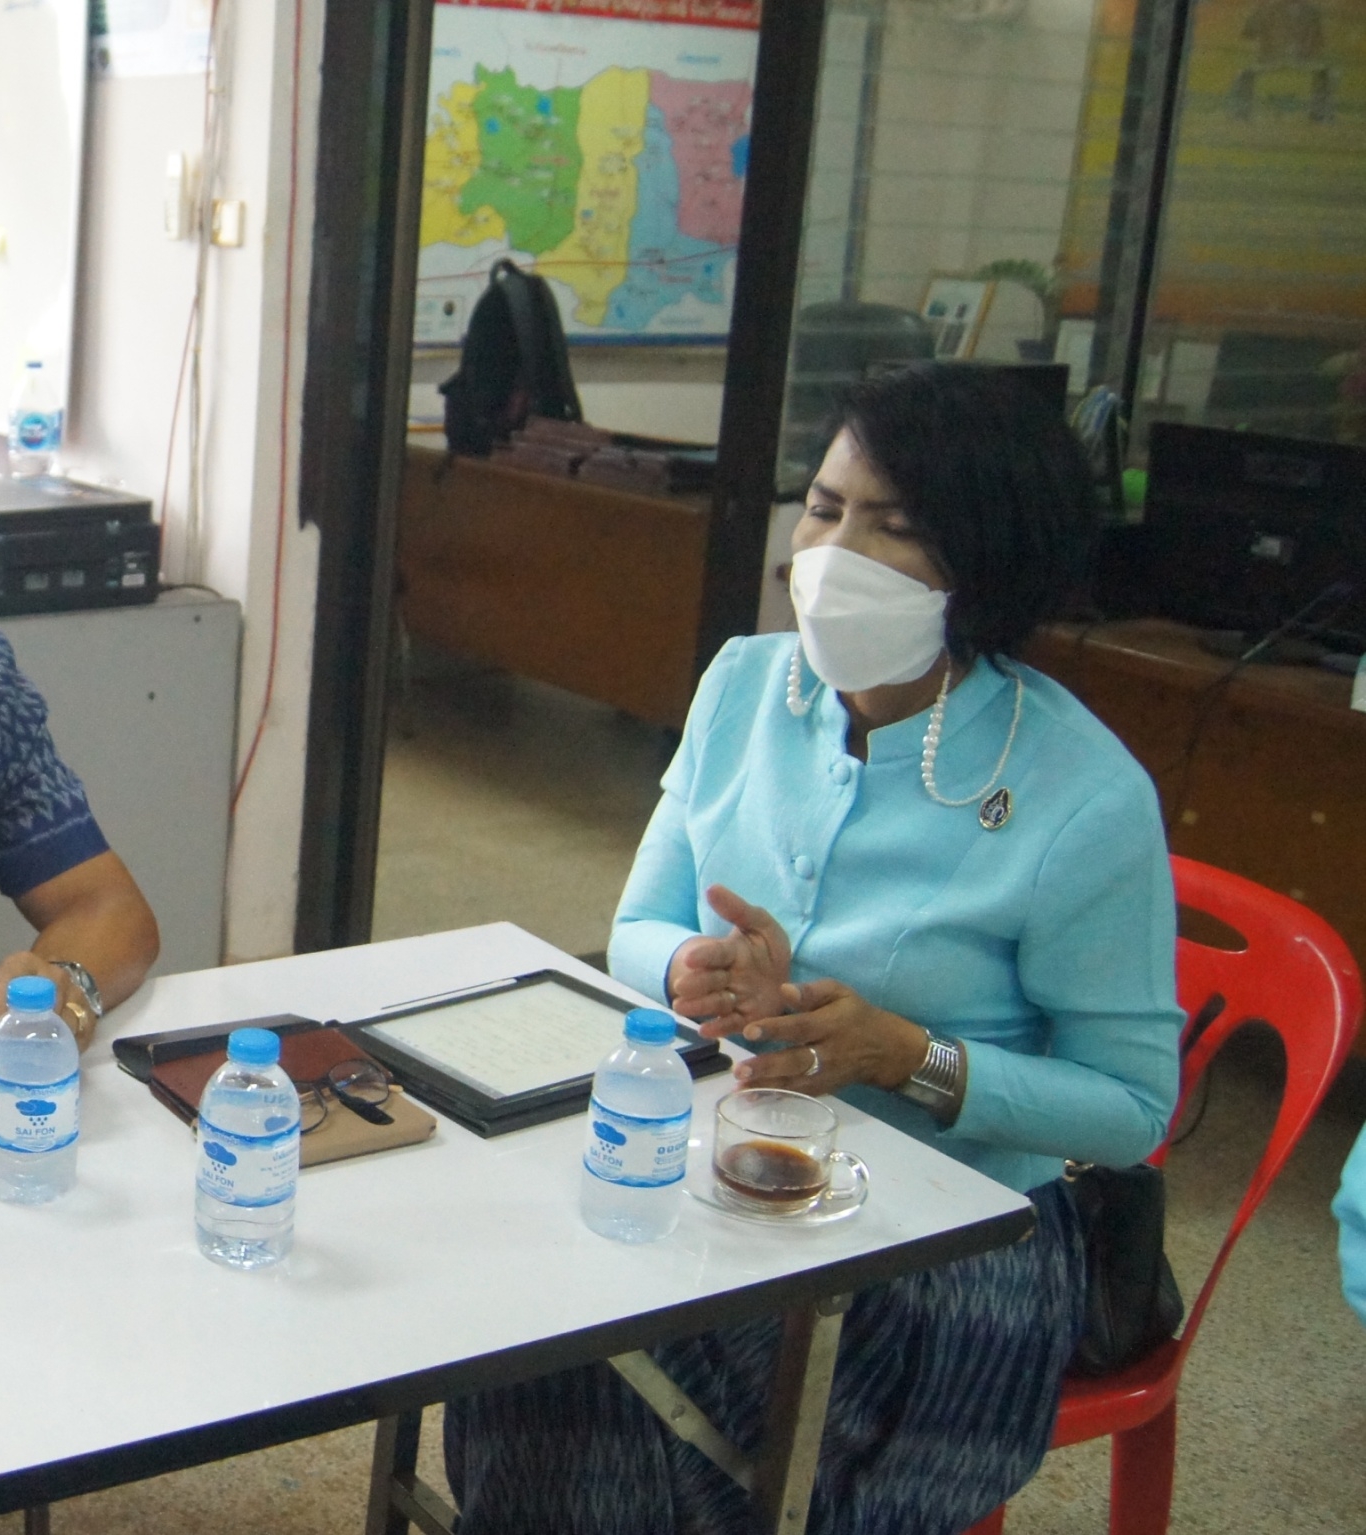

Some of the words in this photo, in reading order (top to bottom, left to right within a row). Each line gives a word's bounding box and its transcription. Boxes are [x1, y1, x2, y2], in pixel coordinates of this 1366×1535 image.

[15, 1127, 32, 1135] SAI
[35, 1126, 56, 1135] FON
[603, 1154, 623, 1167] FON
[214, 1174, 235, 1188] FON
